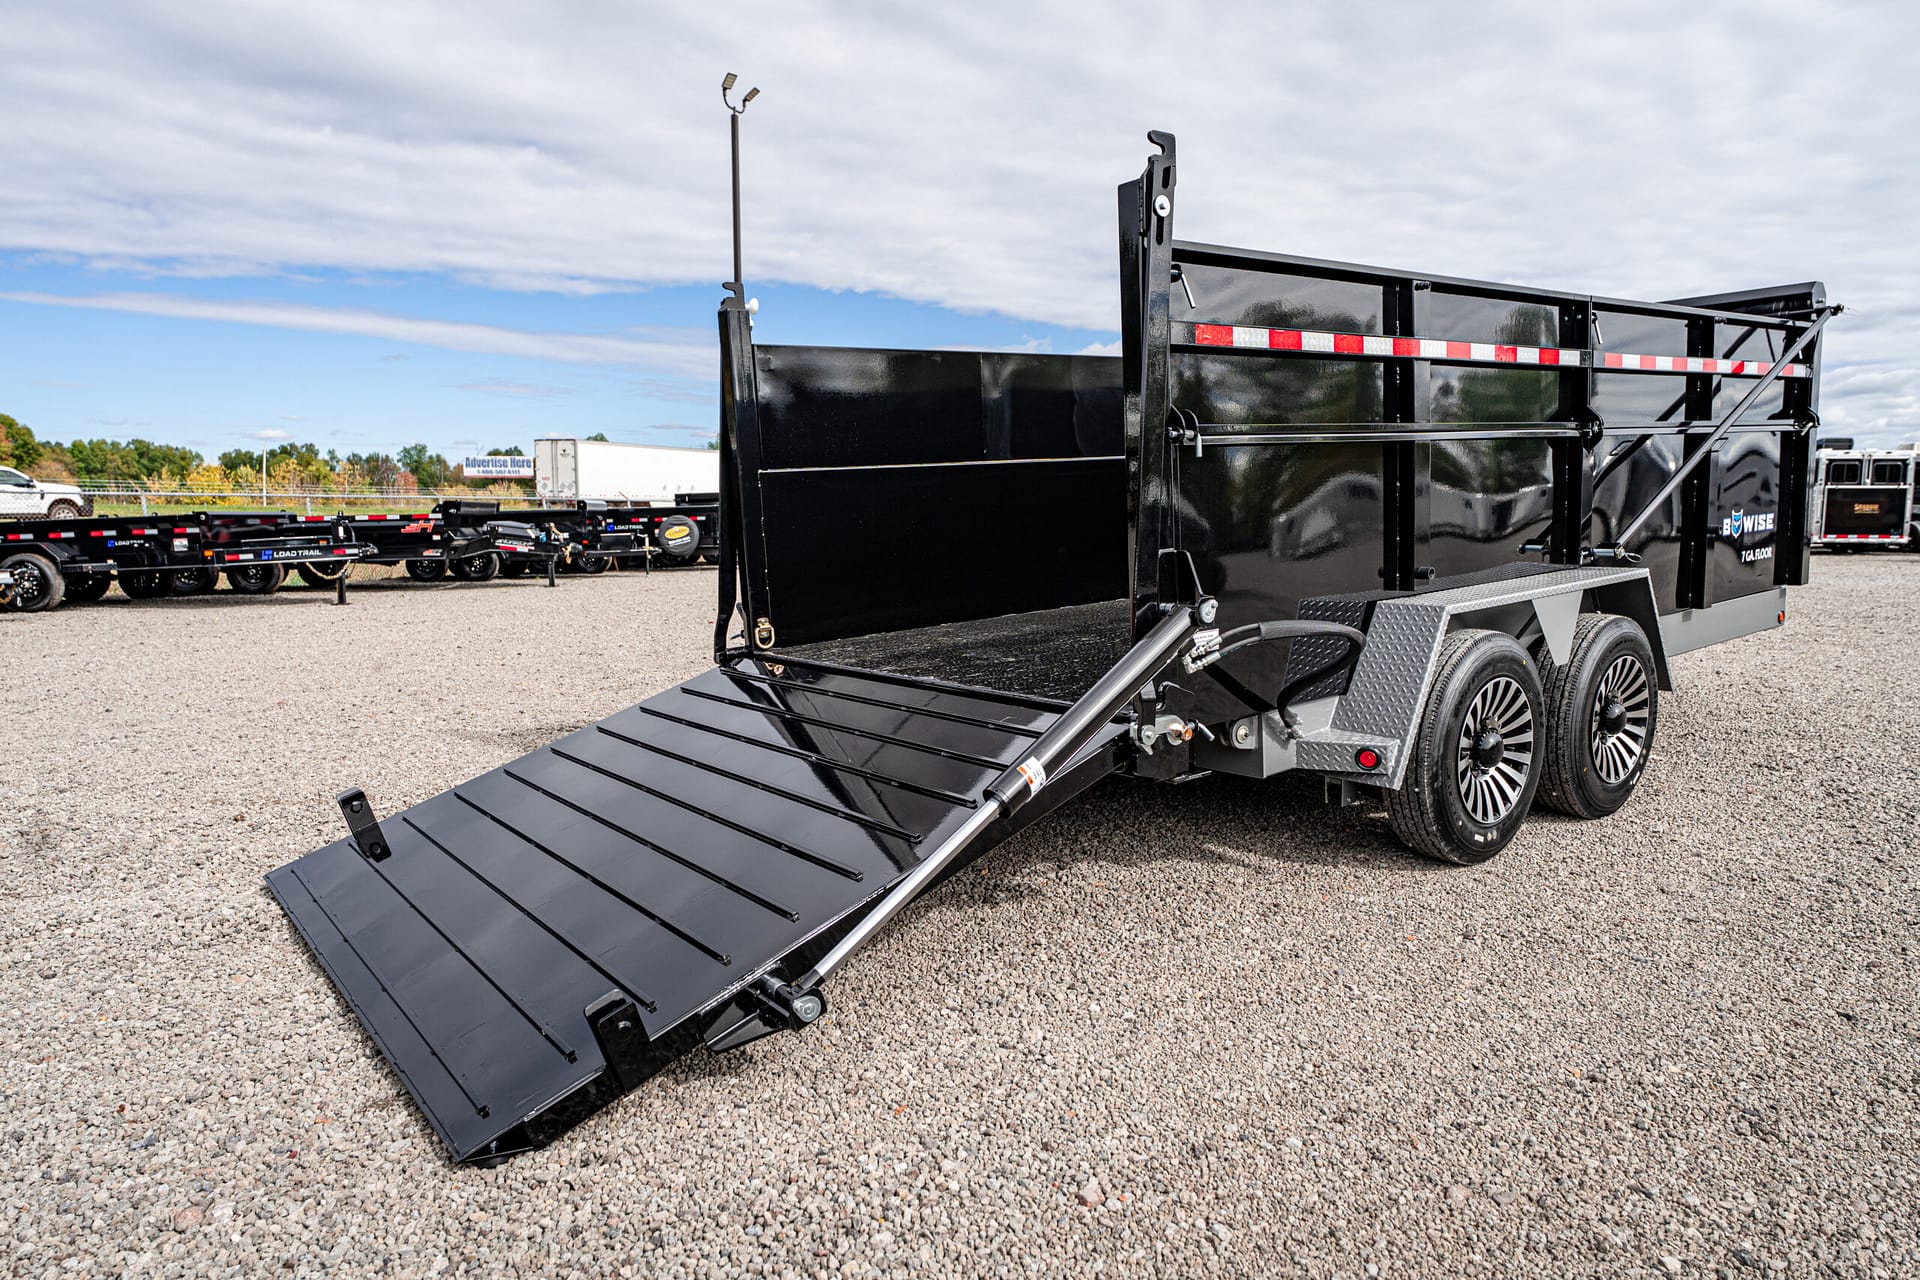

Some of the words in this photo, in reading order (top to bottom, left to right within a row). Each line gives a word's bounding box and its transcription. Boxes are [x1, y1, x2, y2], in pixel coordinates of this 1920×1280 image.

[465, 457, 508, 469] Advertise
[510, 457, 532, 469] Here
[273, 550, 297, 558] LOAD
[298, 549, 322, 557] TRAIL
[1754, 546, 1772, 560] FLOOR
